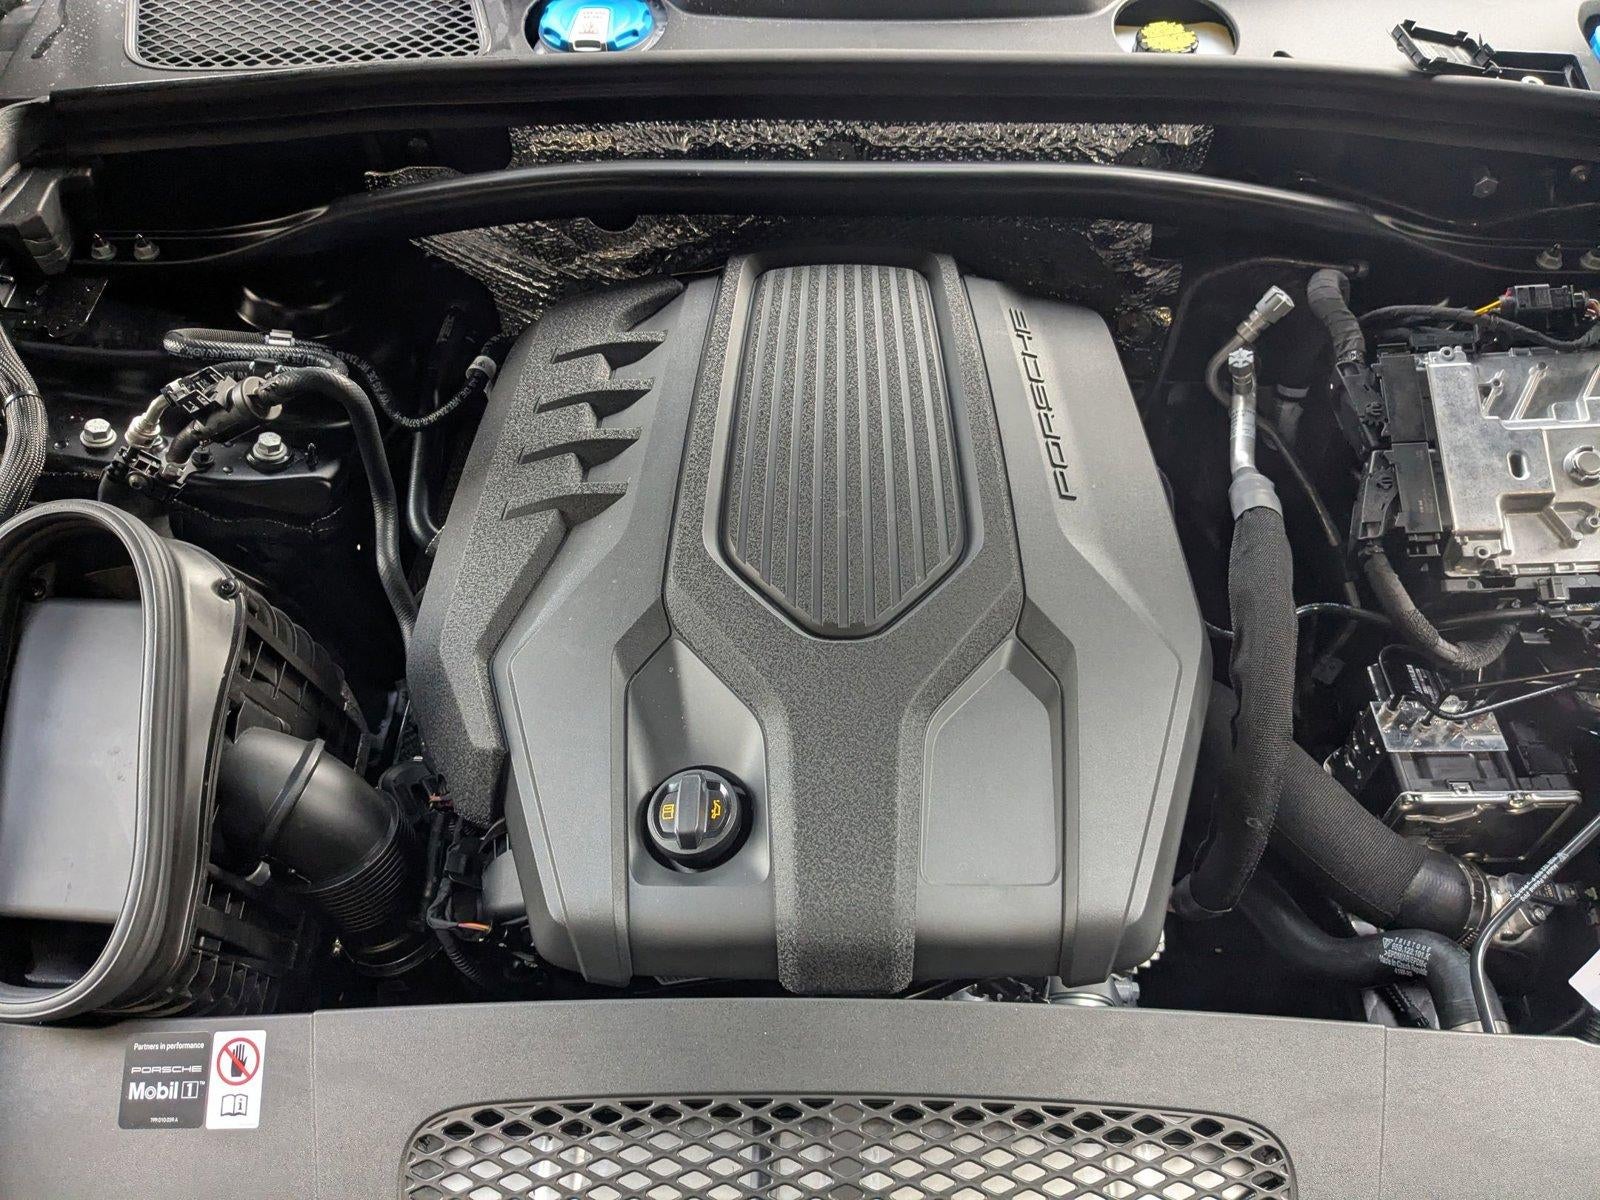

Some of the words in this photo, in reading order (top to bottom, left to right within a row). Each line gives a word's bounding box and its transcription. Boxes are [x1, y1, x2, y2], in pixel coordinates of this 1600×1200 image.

[1009, 307, 1077, 500] PORSCHE
[133, 1043, 160, 1051] Partners
[166, 1042, 205, 1051] performance
[131, 1065, 203, 1074] PORSCHE
[128, 1081, 179, 1100] Mobil
